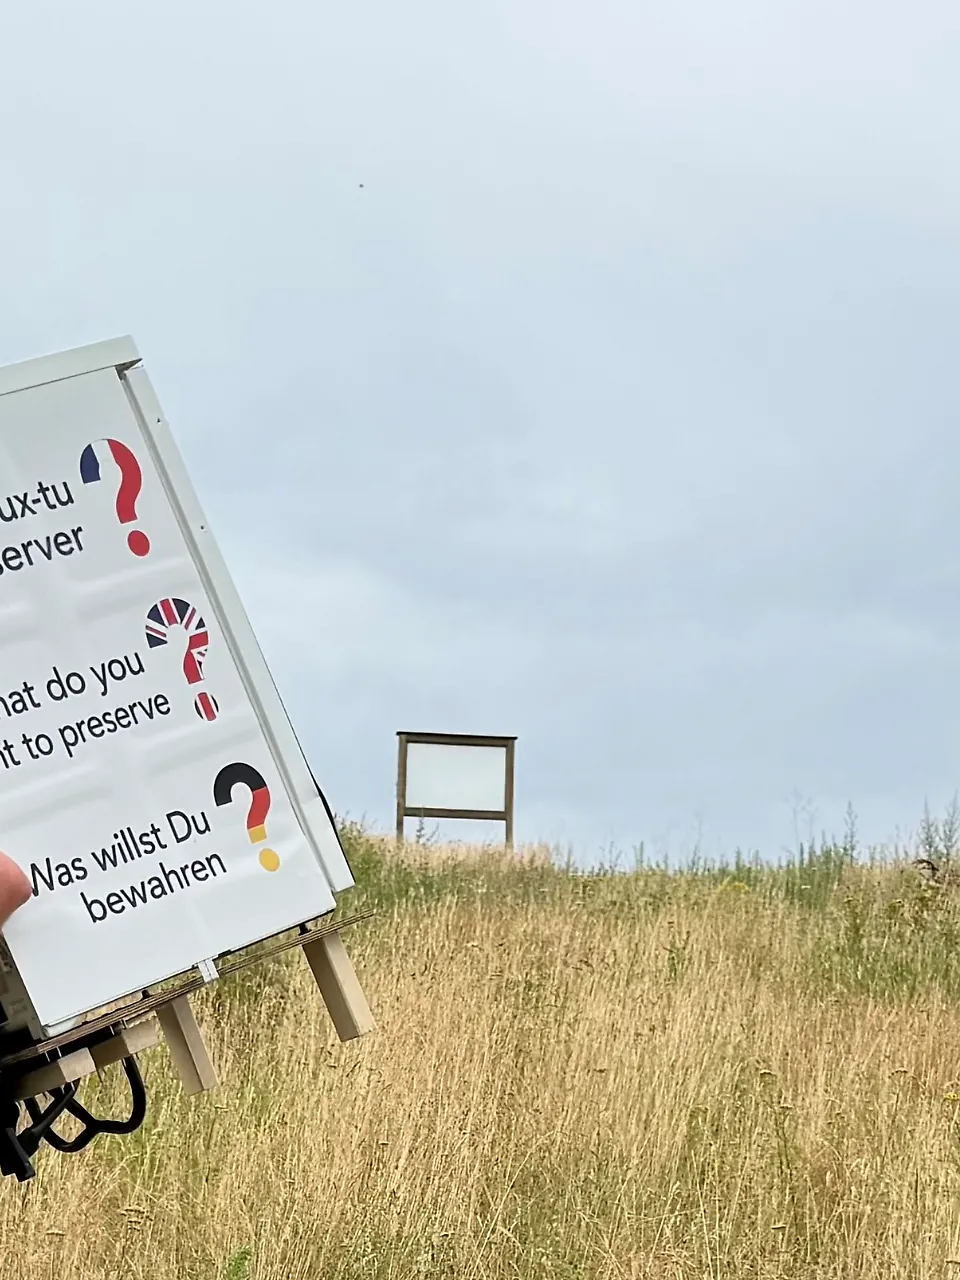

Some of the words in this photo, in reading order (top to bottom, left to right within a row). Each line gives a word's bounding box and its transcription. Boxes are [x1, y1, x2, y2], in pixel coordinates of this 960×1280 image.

[46, 666, 86, 701] do
[89, 652, 145, 697] you
[21, 733, 54, 760] to
[58, 692, 171, 758] preserve
[90, 823, 167, 872] willst
[165, 810, 211, 844] Du
[79, 853, 227, 924] bewahren
